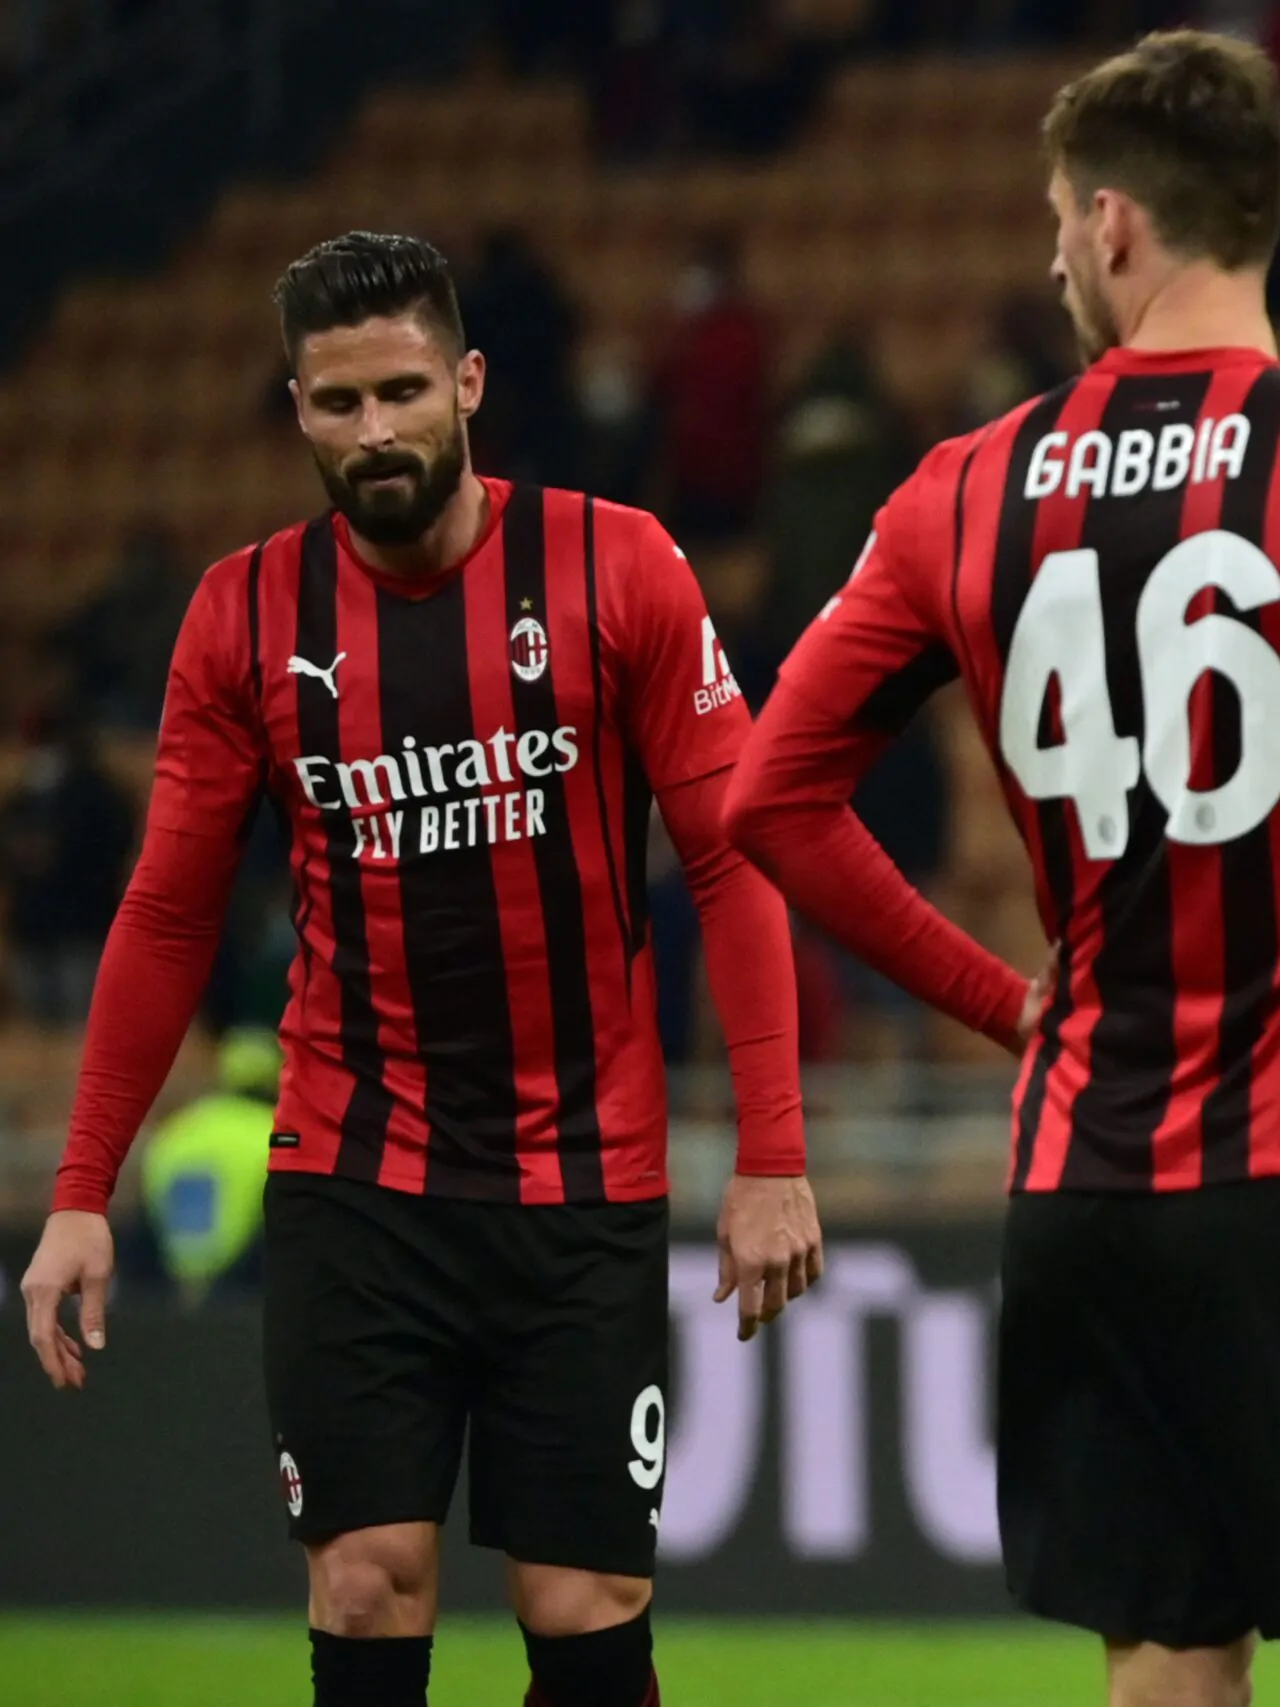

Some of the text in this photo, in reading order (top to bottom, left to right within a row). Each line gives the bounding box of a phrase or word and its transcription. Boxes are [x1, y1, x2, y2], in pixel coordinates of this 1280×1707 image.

[1024, 413, 1251, 500] GABBIA
[292, 725, 579, 810] Emirates
[351, 788, 547, 859] FLY BETTER
[627, 1384, 665, 1490] 9
